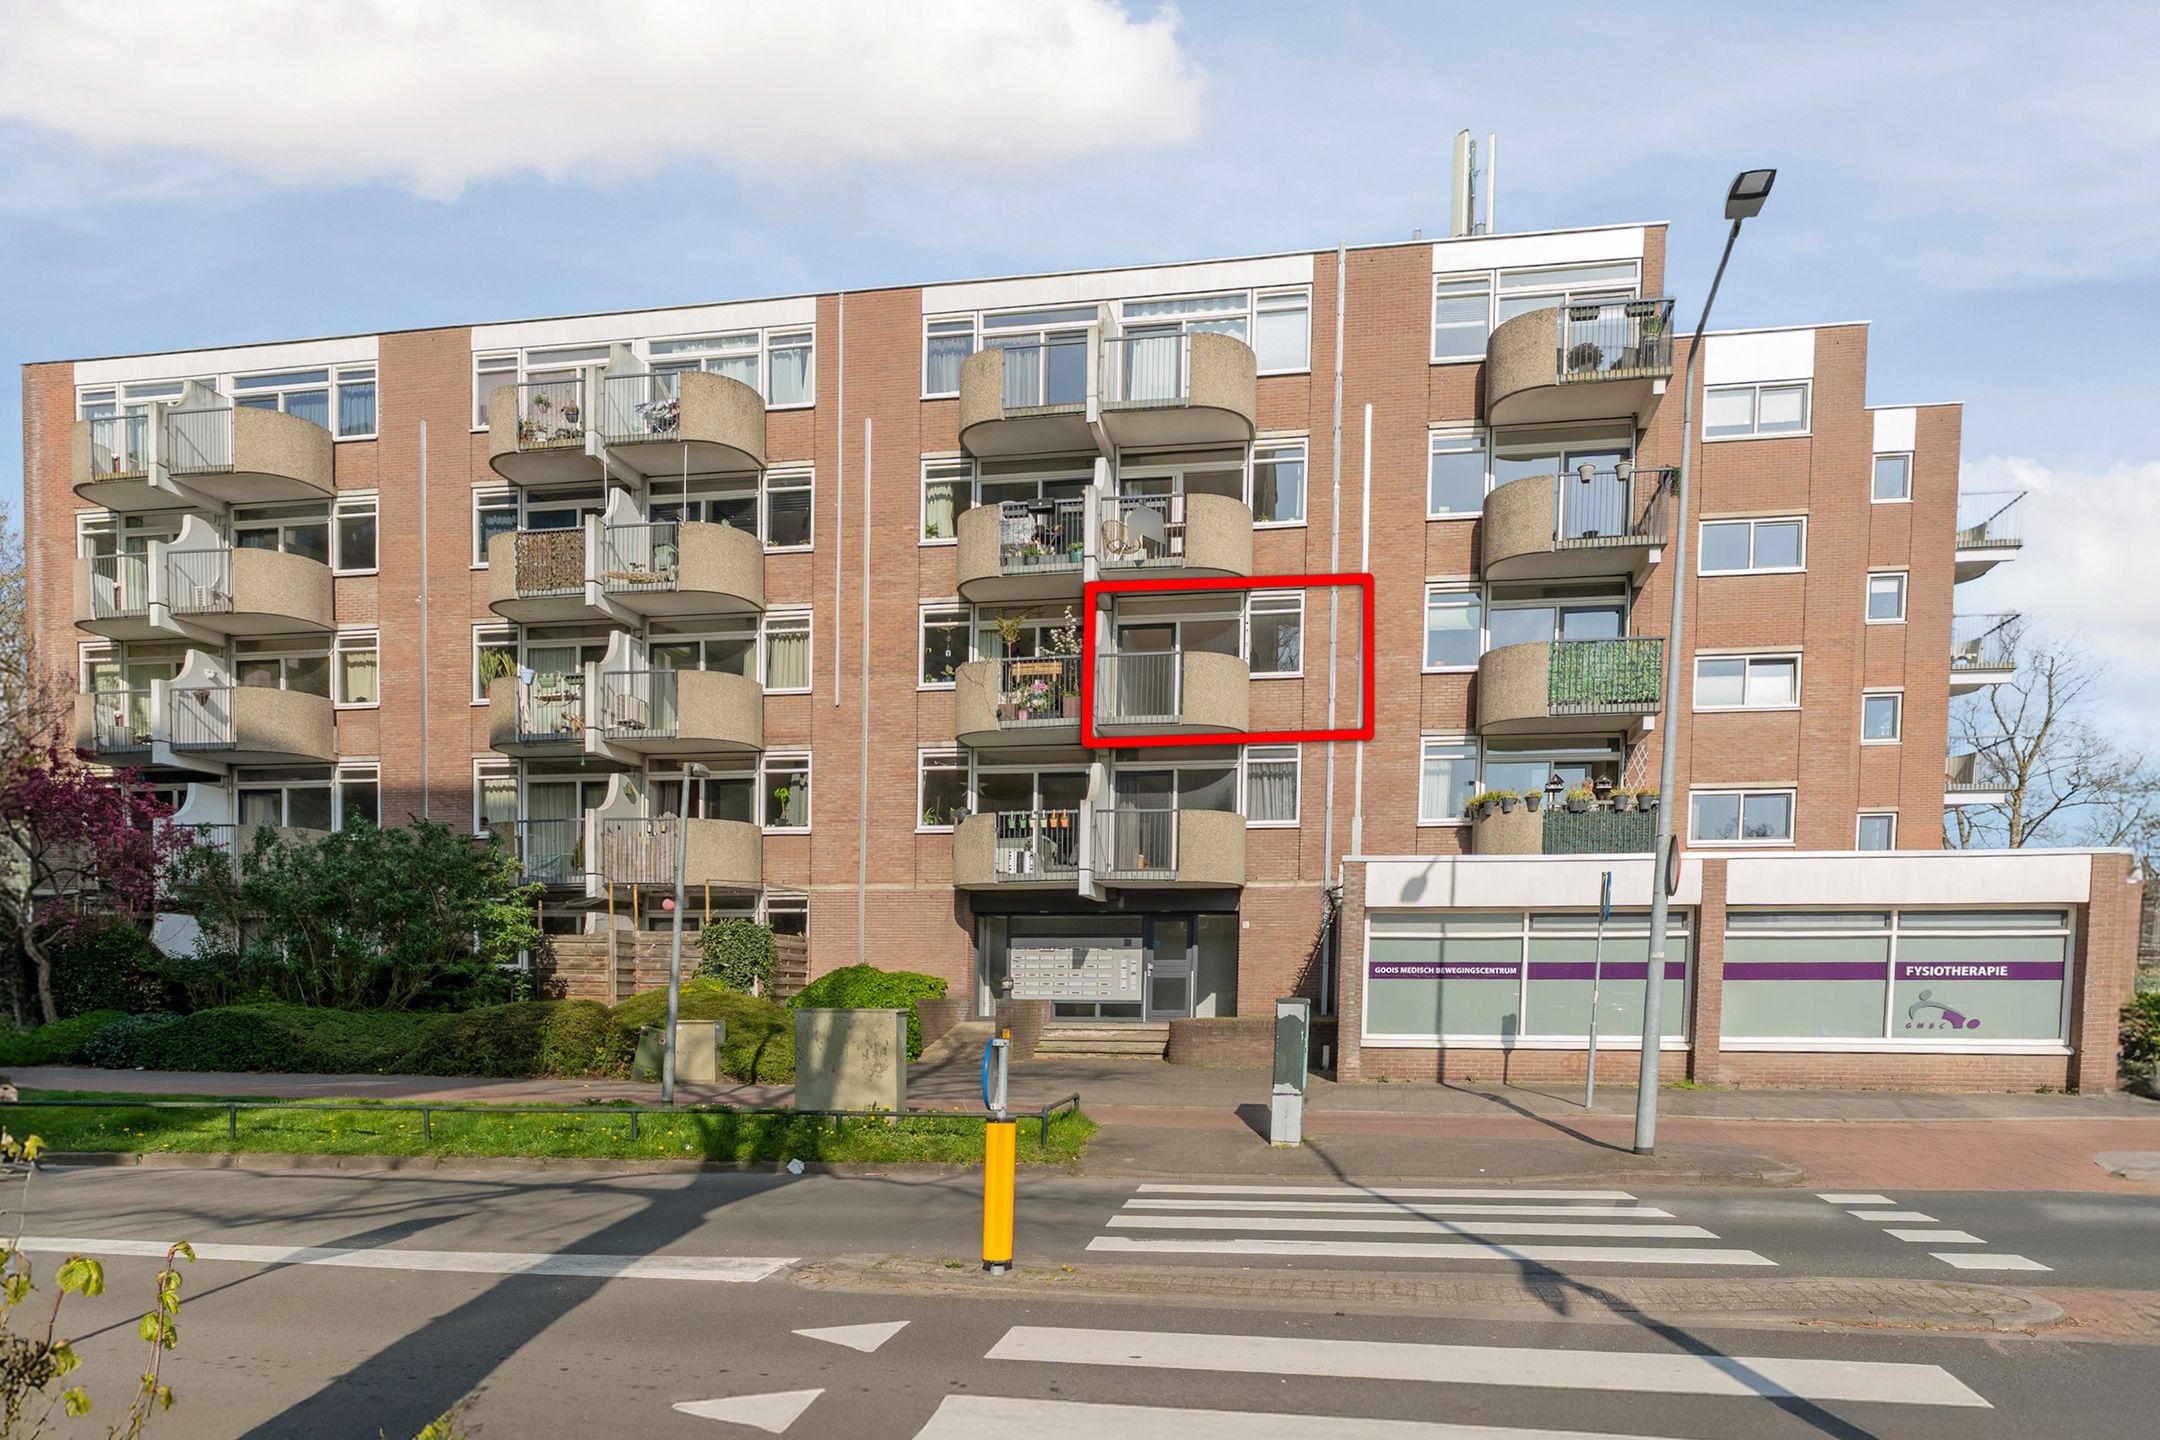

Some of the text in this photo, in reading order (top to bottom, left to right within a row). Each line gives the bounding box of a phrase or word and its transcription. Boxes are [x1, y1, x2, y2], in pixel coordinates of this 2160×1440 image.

[1374, 966, 1399, 974] GOOIS
[1400, 966, 1435, 974] MEDISCH
[1906, 966, 2008, 976] FYSIOTHERAPIE
